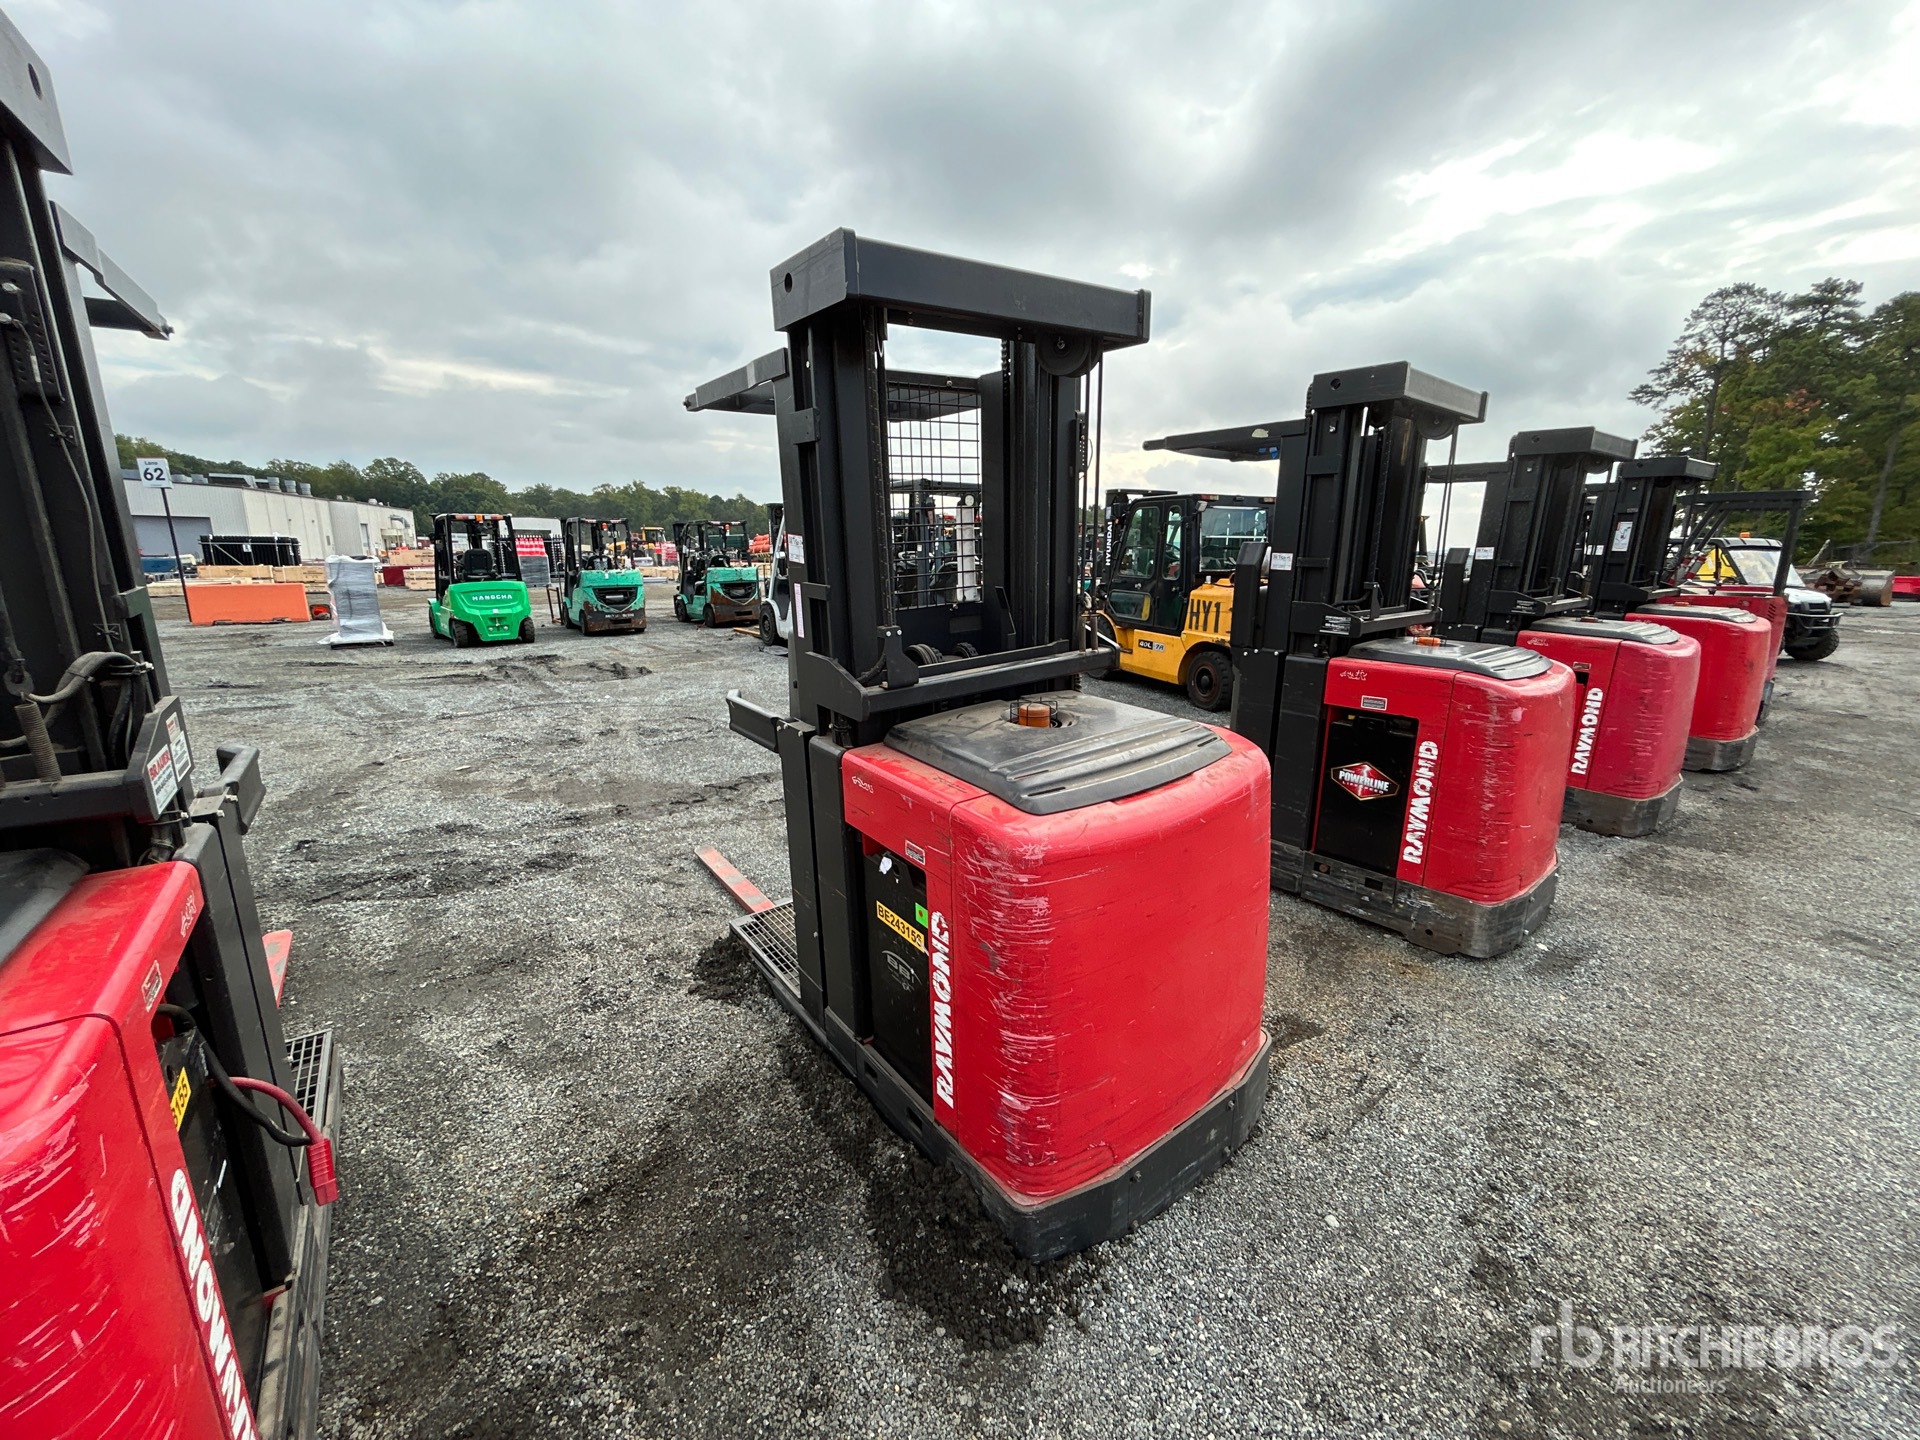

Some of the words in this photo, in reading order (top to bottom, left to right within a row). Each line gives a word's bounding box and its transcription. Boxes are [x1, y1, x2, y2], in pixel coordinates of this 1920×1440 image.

[143, 467, 166, 481] 62
[1105, 521, 1113, 566] HYUNDAI
[1189, 599, 1236, 634] HY1
[1571, 687, 1603, 775] RAYMOND
[1339, 770, 1390, 792] POWERLINE
[1403, 740, 1438, 864] RAYMOND
[171, 1168, 262, 1440] AYMOND
